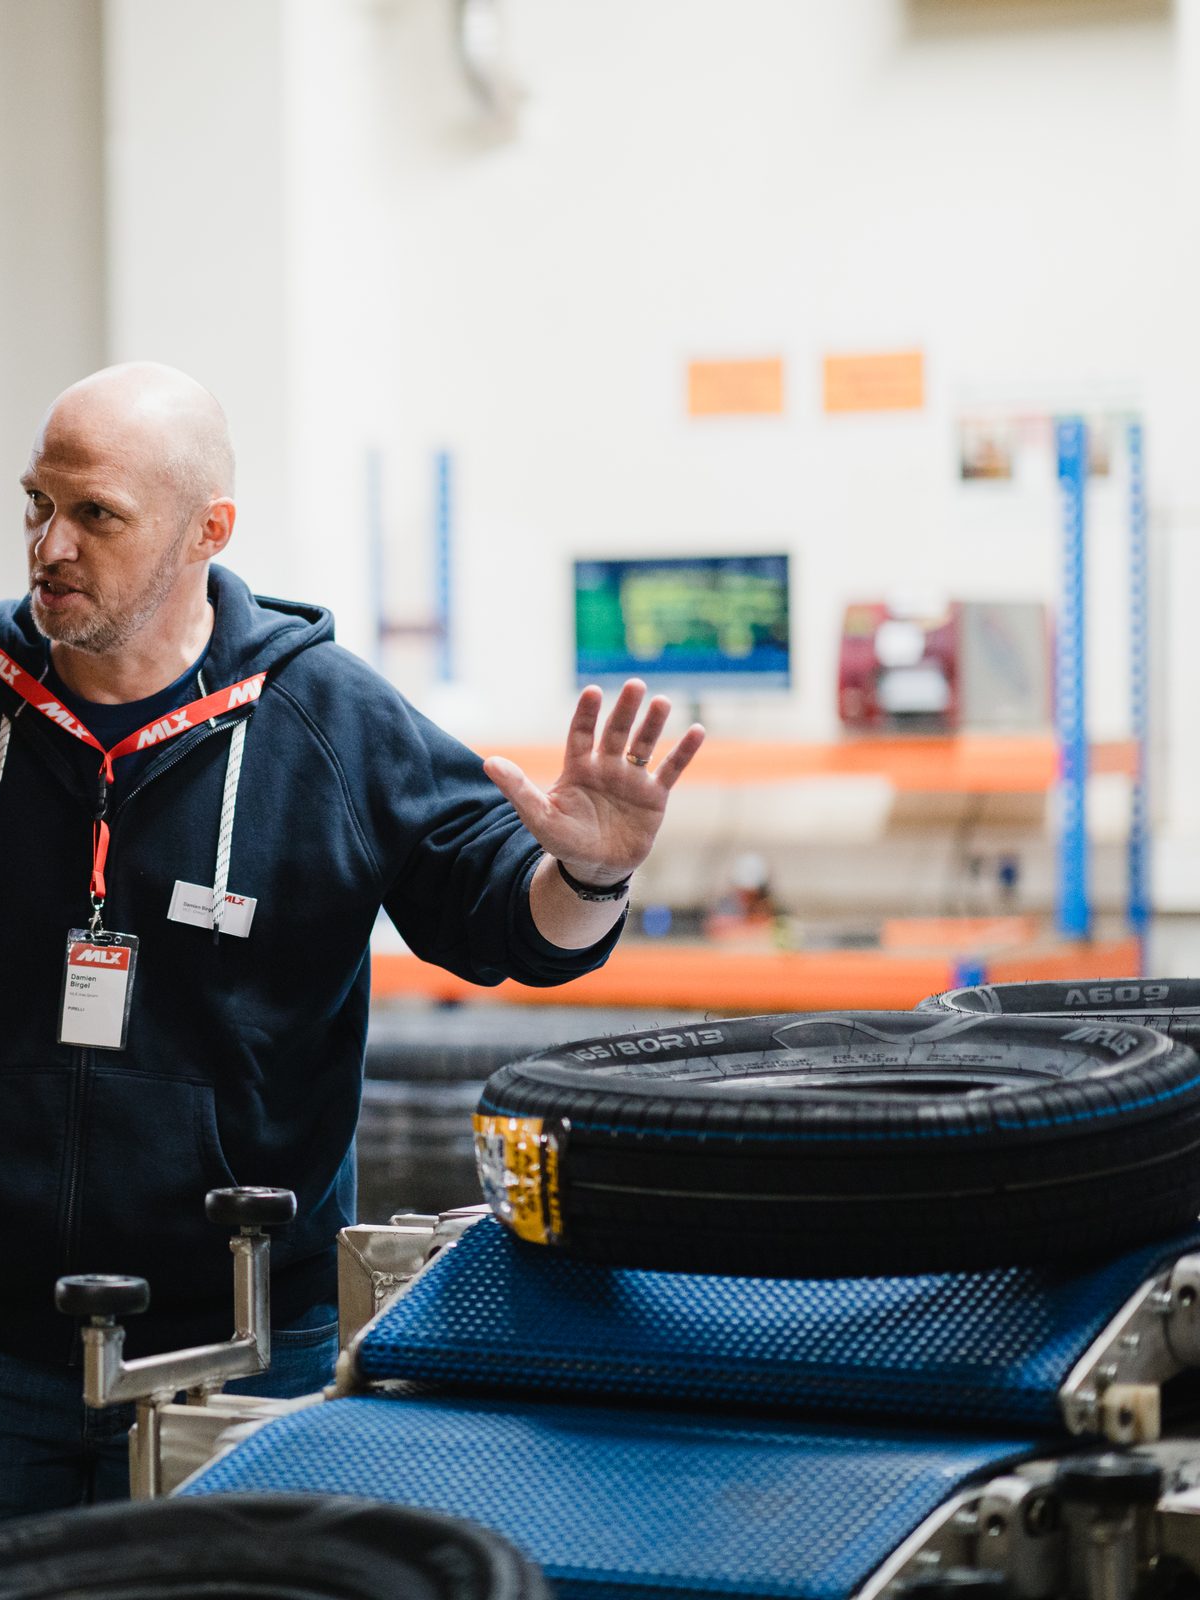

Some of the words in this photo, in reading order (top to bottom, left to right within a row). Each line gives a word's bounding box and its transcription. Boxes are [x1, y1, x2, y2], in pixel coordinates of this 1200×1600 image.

[37, 701, 90, 740] MLX
[136, 710, 193, 750] MLX
[76, 949, 122, 965] MLX
[69, 981, 91, 989] Birgel
[70, 973, 97, 982] Damien
[1064, 985, 1170, 1006] A609
[565, 1029, 725, 1062] 165/80R13
